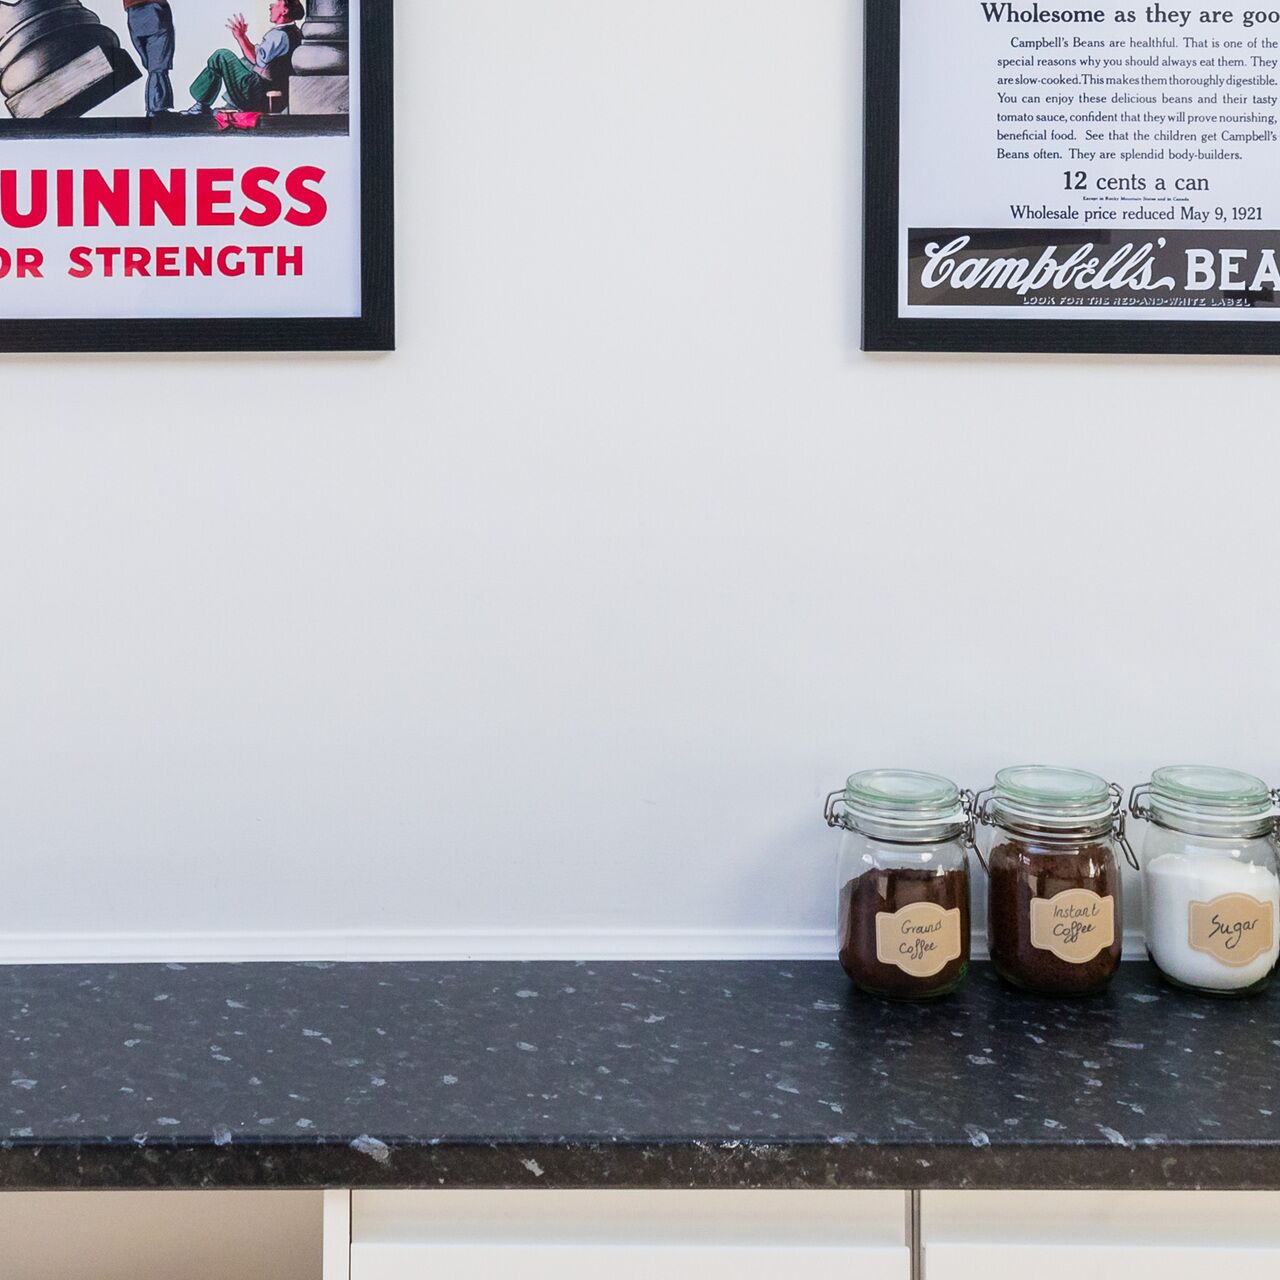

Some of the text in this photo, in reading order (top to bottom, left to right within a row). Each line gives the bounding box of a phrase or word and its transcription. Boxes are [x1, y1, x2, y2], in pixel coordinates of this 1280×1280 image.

[980, 2, 1104, 22] Wholesome
[1114, 10, 1136, 22] as
[1146, 3, 1191, 27] they
[1200, 11, 1233, 22] are
[1010, 36, 1068, 51] Campbell's
[1073, 37, 1105, 48] Beans
[1130, 37, 1178, 48] healthful.
[1182, 37, 1208, 48] That
[1212, 38, 1220, 49] is
[1223, 41, 1242, 49] one
[1247, 37, 1257, 49] of
[1262, 37, 1278, 49] the
[997, 55, 1278, 70] special reasons why you should always eat them. They
[1106, 74, 1140, 85] makes
[1141, 74, 1167, 85] them
[1169, 74, 1224, 88] thoroughly
[1226, 74, 1277, 88] digestible.
[997, 92, 1277, 107] You can enjoy these delicious beans and their tasty
[997, 111, 1277, 125] tomato sauce, confident that they will prove nourishing,
[997, 129, 1277, 144] beneficial food. See that the children get Campbell's
[997, 148, 1242, 162] Beans often. They are splendid body-builders.
[1064, 171, 1209, 190] 12 cents a can
[1010, 205, 1262, 222] Wholesale price reduced May 9, 1921
[68, 245, 303, 279] STRENGTH
[1023, 297, 1055, 306] LOOK
[1060, 297, 1084, 306] FOR
[1088, 297, 1110, 306] THE
[1211, 297, 1251, 307] LABEL
[1053, 903, 1100, 919] Instant
